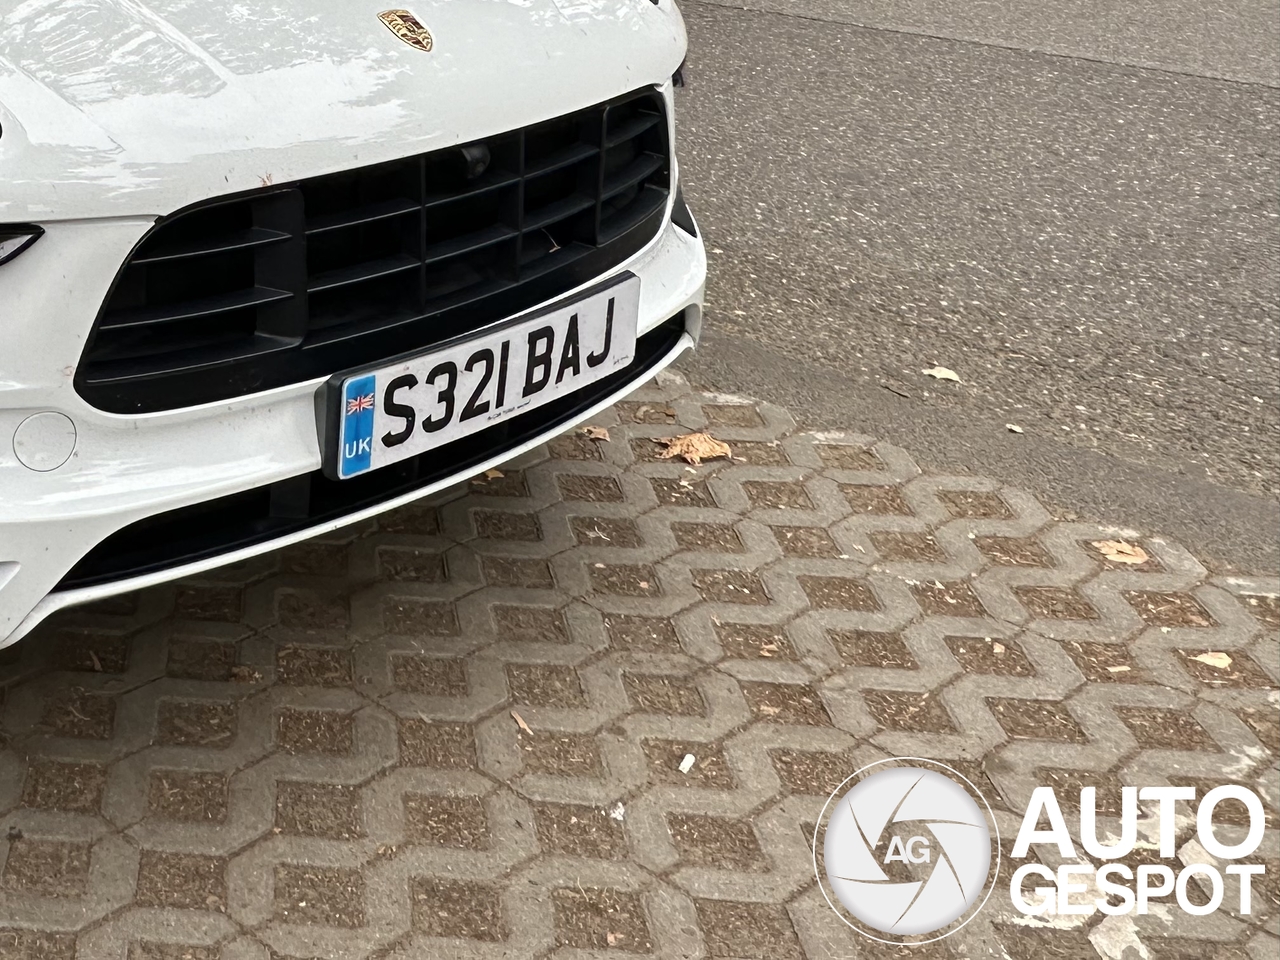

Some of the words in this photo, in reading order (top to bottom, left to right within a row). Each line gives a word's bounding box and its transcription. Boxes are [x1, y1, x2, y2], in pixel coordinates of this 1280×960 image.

[381, 340, 510, 447] S321
[522, 297, 616, 398] BAJ
[345, 436, 370, 459] UK
